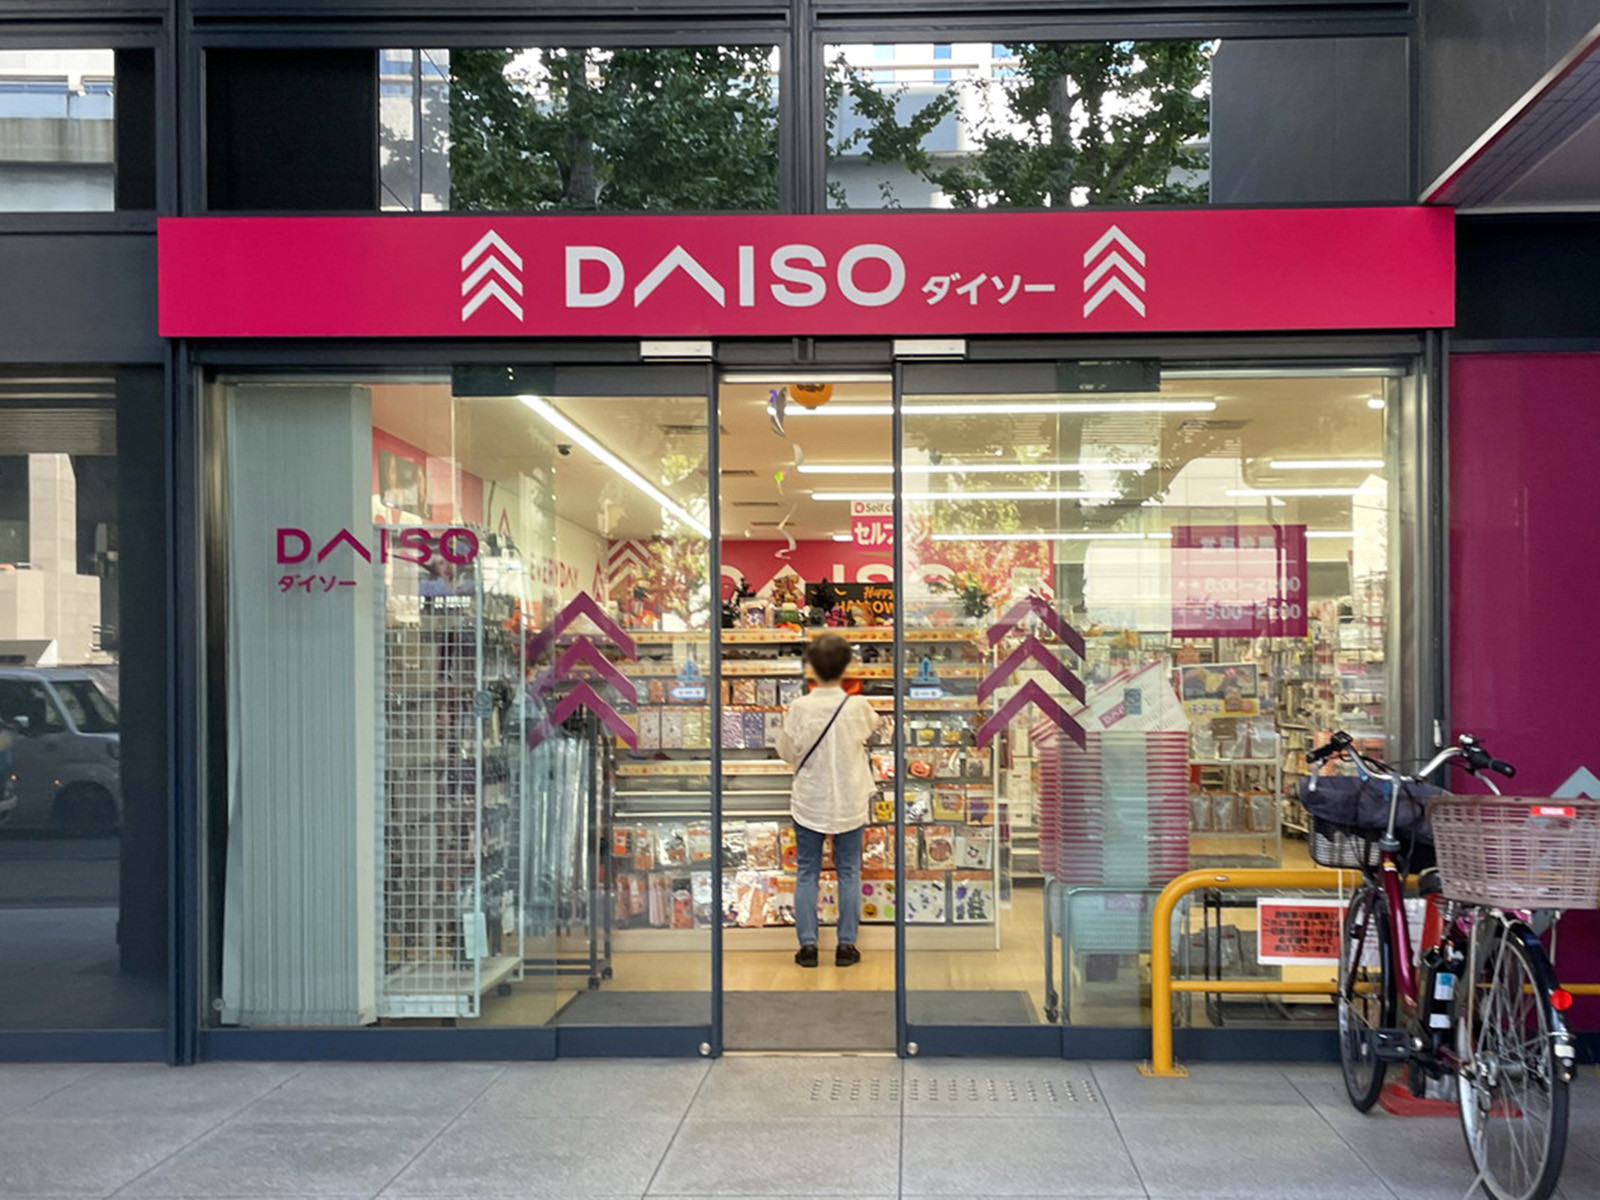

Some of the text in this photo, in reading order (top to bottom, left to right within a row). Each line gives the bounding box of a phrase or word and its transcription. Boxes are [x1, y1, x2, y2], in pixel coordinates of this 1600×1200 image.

[565, 244, 1056, 308] DAISO ダイソー
[276, 528, 479, 564] DAISO
[277, 574, 357, 592] ダイソー
